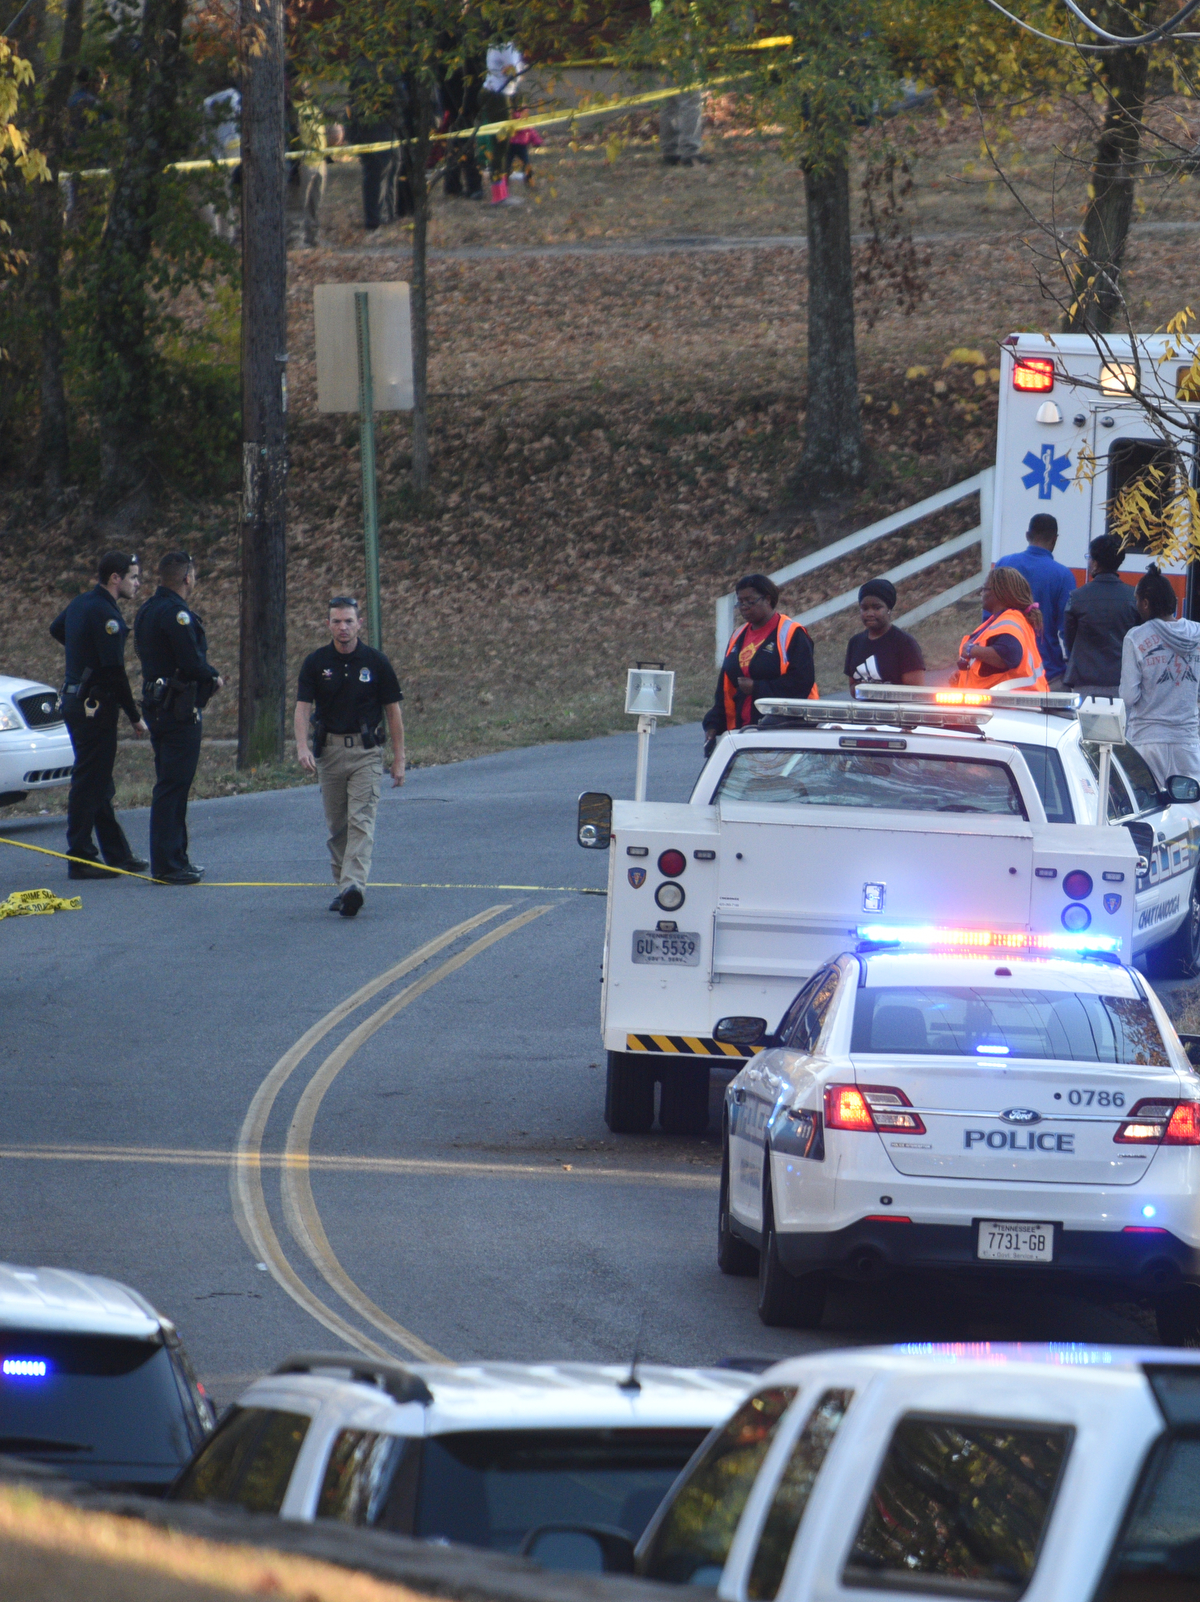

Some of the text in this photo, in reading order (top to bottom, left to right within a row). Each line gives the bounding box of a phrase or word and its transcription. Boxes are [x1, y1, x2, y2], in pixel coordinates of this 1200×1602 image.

[1138, 633, 1160, 653] RED
[1146, 655, 1167, 667] LIVE
[1068, 1089, 1125, 1107] 0786
[1009, 1110, 1033, 1120] Ford
[965, 1130, 1074, 1153] POLICE
[997, 1225, 1036, 1233] TENNESSEE
[988, 1232, 1046, 1251] 7731-GB
